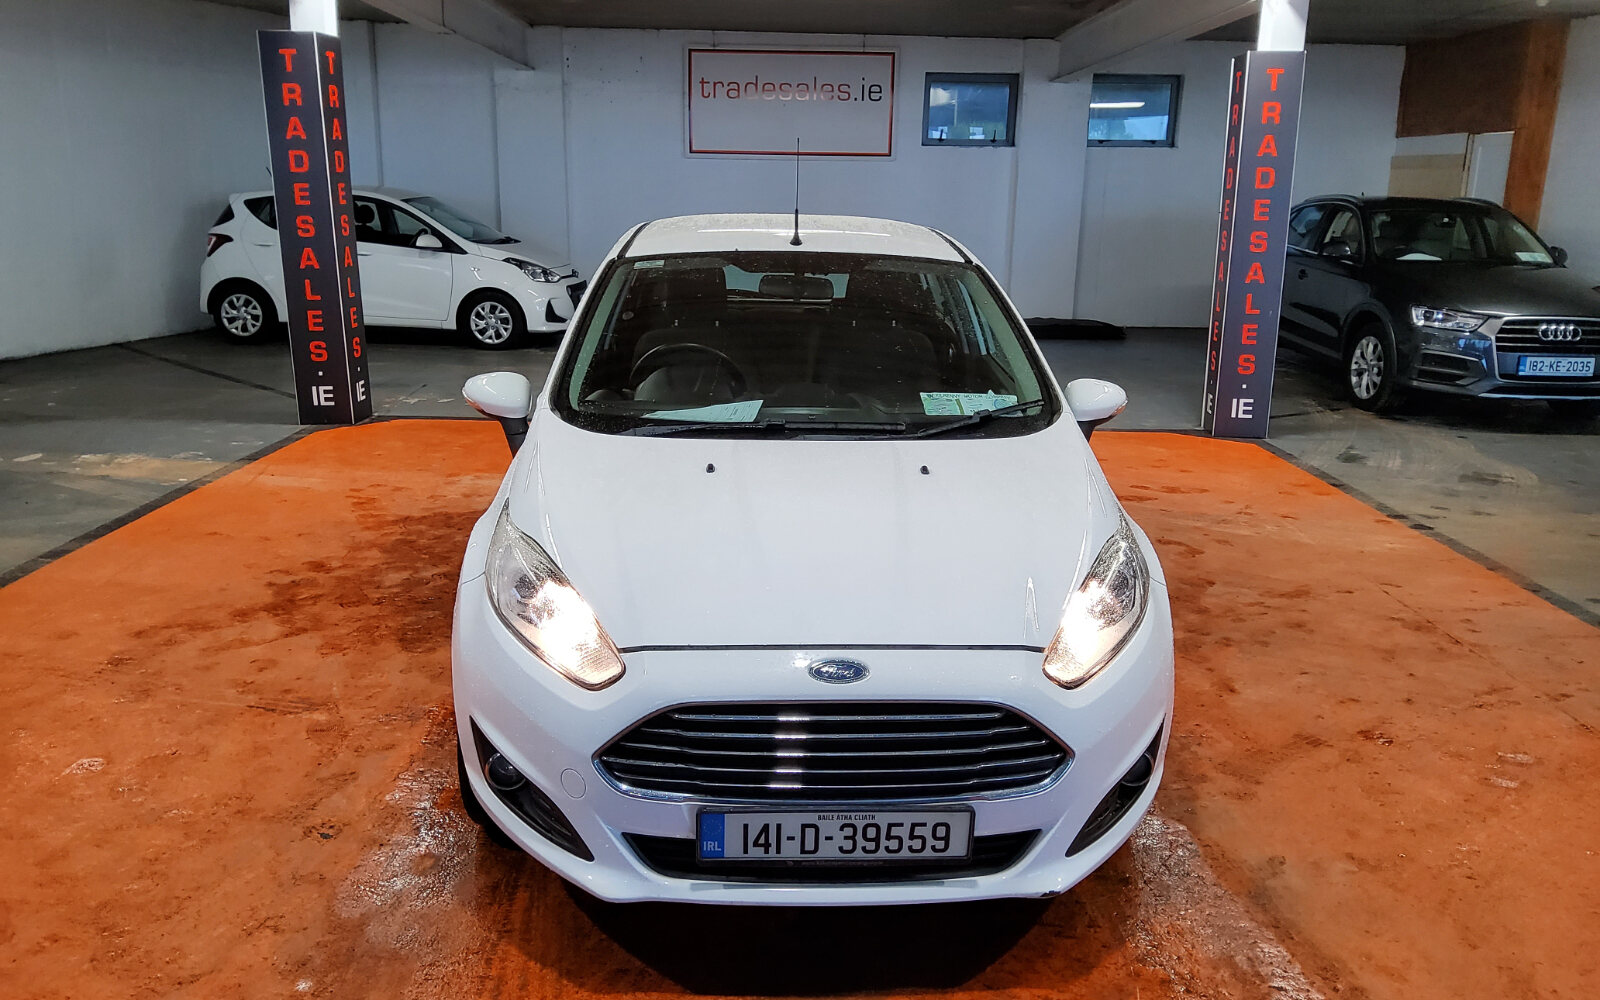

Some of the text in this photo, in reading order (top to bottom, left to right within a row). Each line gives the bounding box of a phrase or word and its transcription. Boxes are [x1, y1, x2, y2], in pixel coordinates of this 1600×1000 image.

[699, 75, 883, 102] tradesales.ie
[1528, 360, 1592, 372] 182-KE-2035
[703, 841, 722, 851] IRL
[741, 822, 951, 855] 141-D-39559
